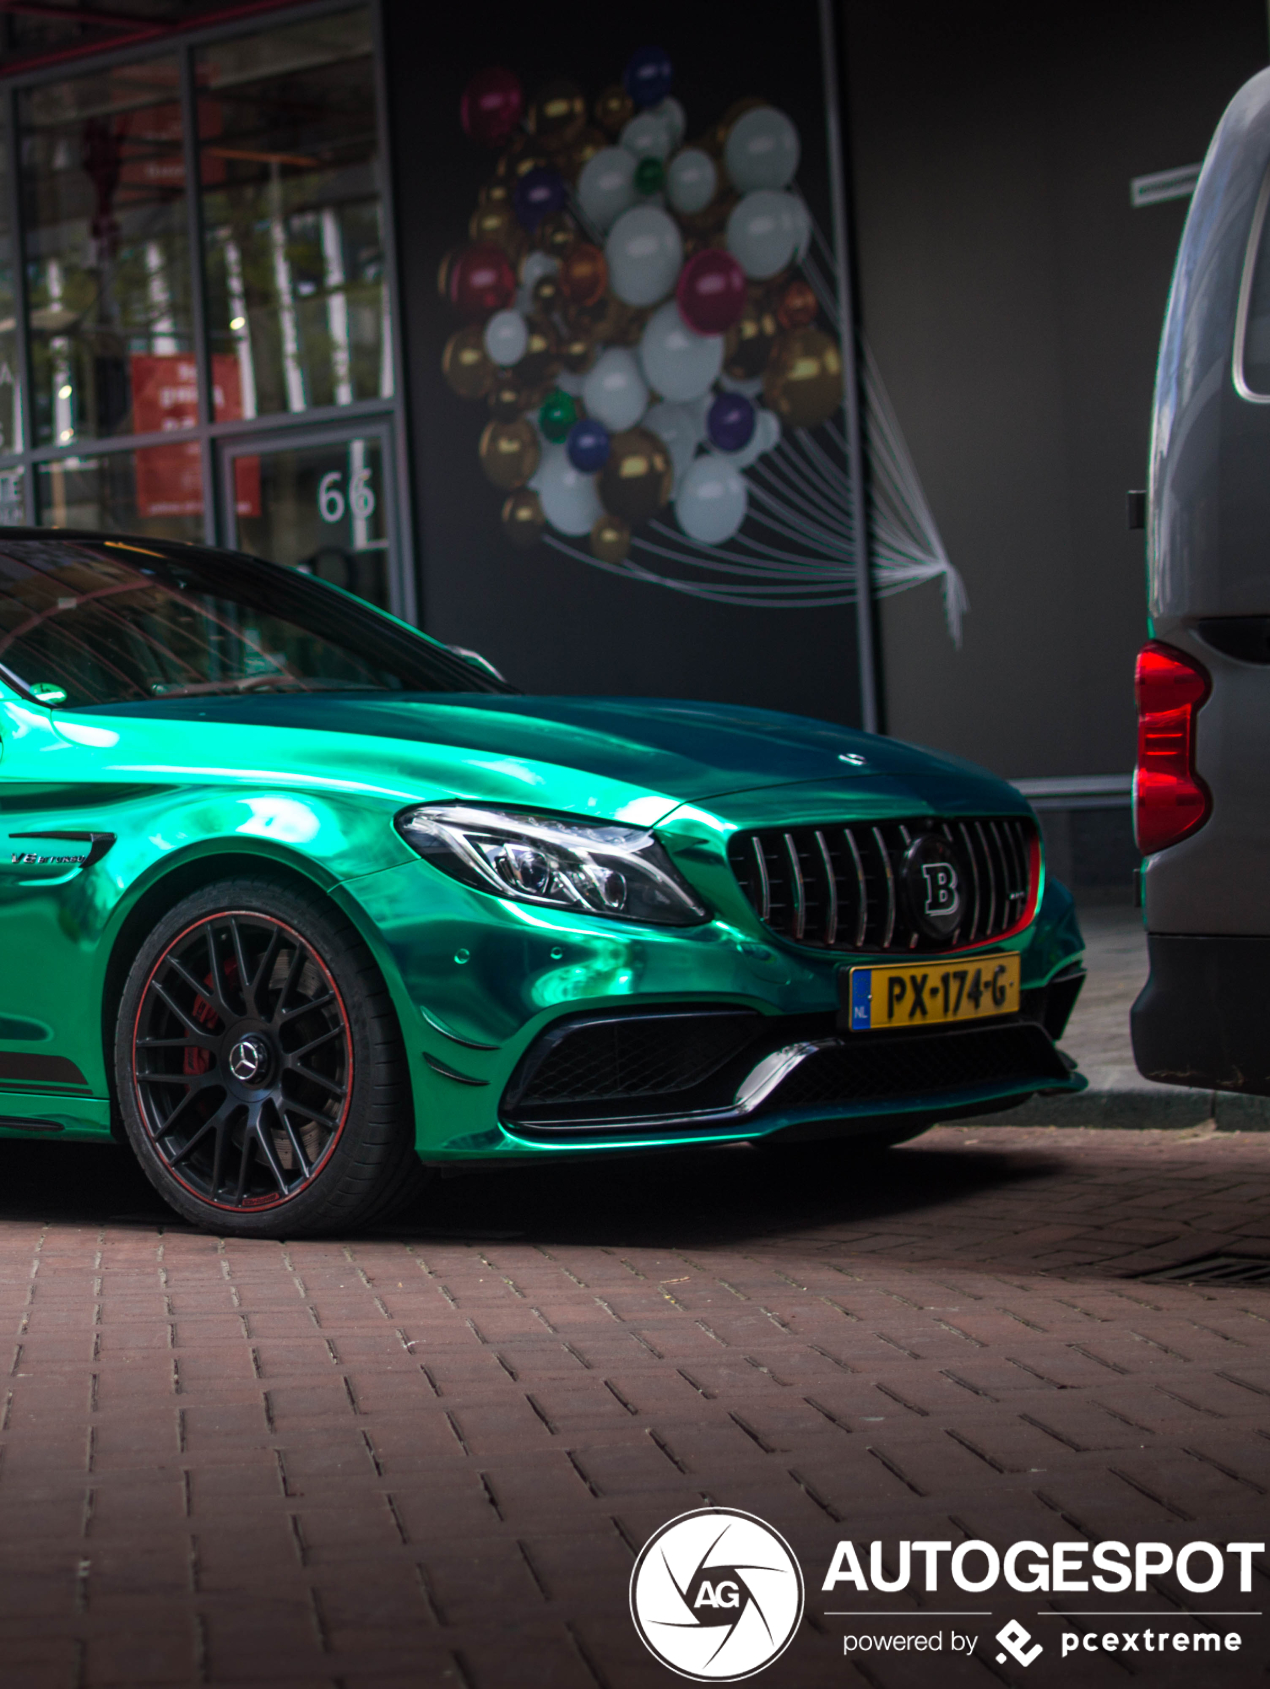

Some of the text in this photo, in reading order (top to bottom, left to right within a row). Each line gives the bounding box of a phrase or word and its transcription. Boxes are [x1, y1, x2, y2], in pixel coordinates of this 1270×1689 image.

[318, 467, 375, 523] 66
[922, 862, 960, 917] B
[854, 1006, 869, 1019] NL
[887, 964, 1007, 1022] PX-174-G
